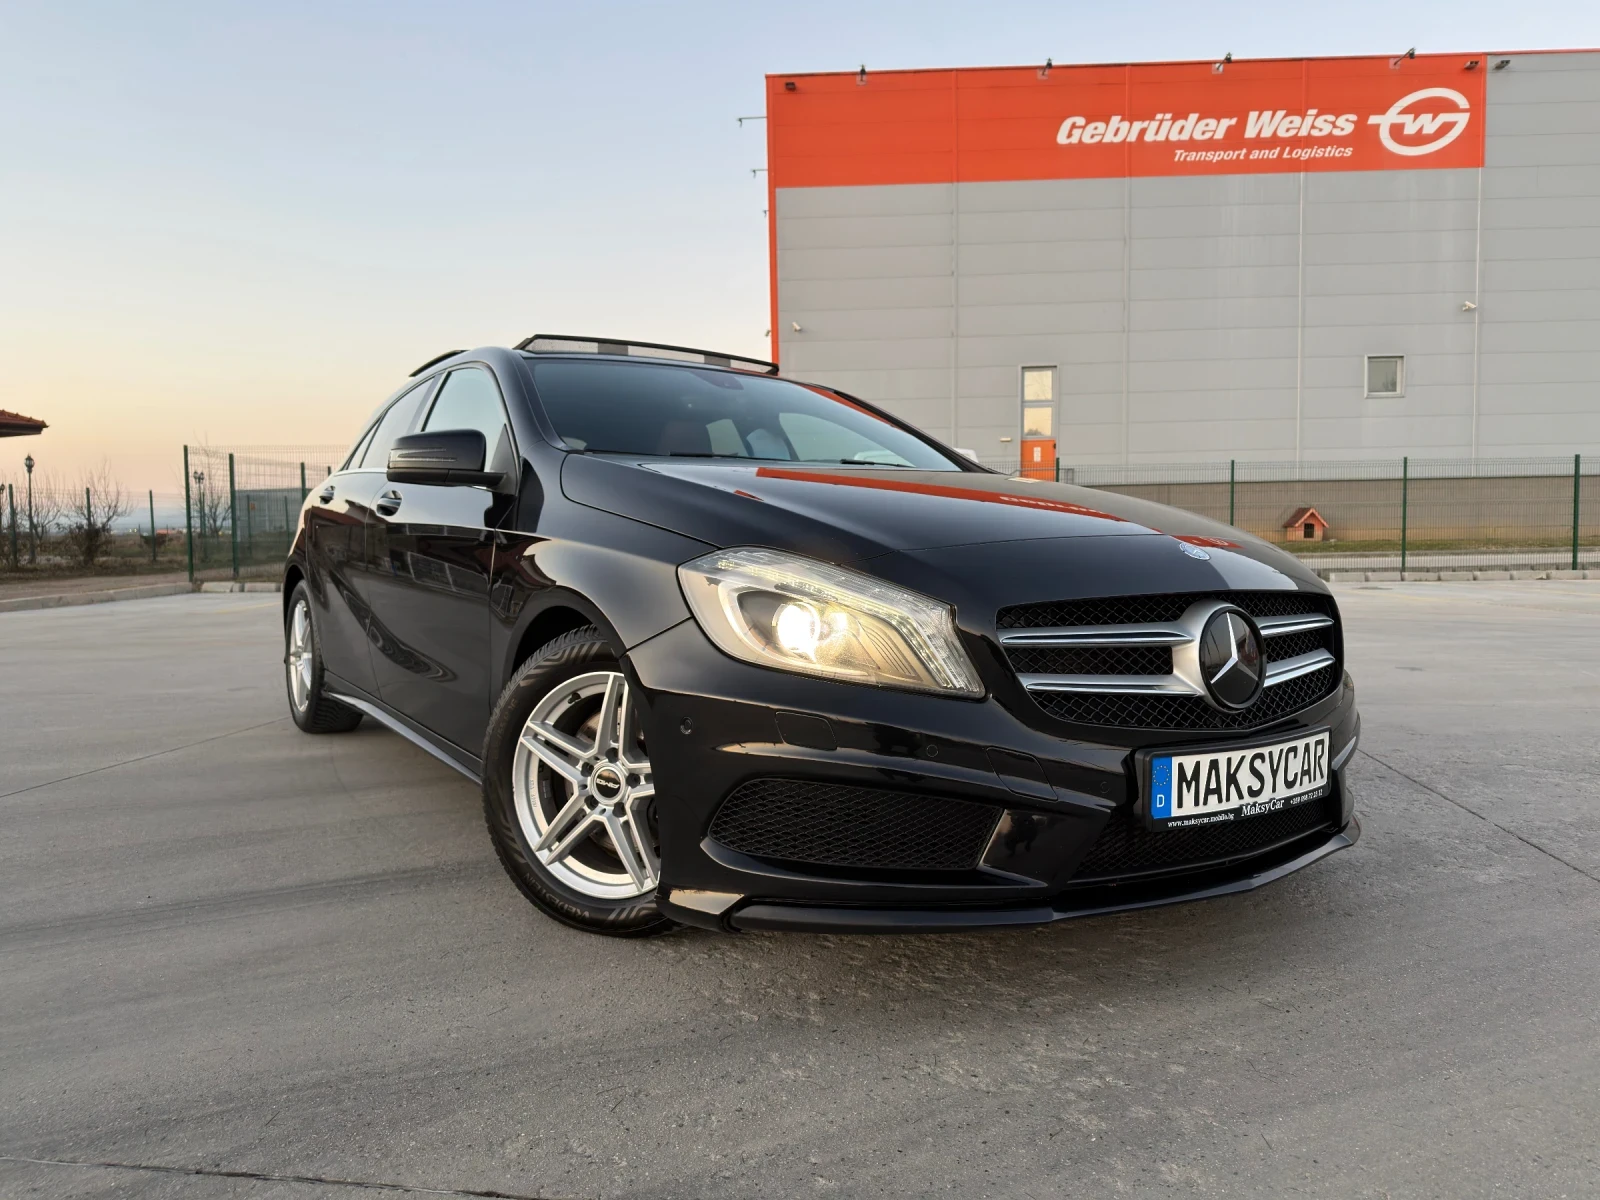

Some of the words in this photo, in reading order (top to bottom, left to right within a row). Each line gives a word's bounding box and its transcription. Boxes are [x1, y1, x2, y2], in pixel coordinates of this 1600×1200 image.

[1056, 112, 1237, 145] Gebrüder
[1243, 108, 1358, 139] Weiss
[1174, 147, 1246, 163] Transport
[1249, 146, 1280, 160] and
[1282, 145, 1354, 161] Logistics
[1176, 738, 1325, 809] MAKSYCAR
[1156, 794, 1165, 808] D
[1240, 798, 1285, 817] MaksyCar
[521, 872, 590, 920] VREDESTEIN
